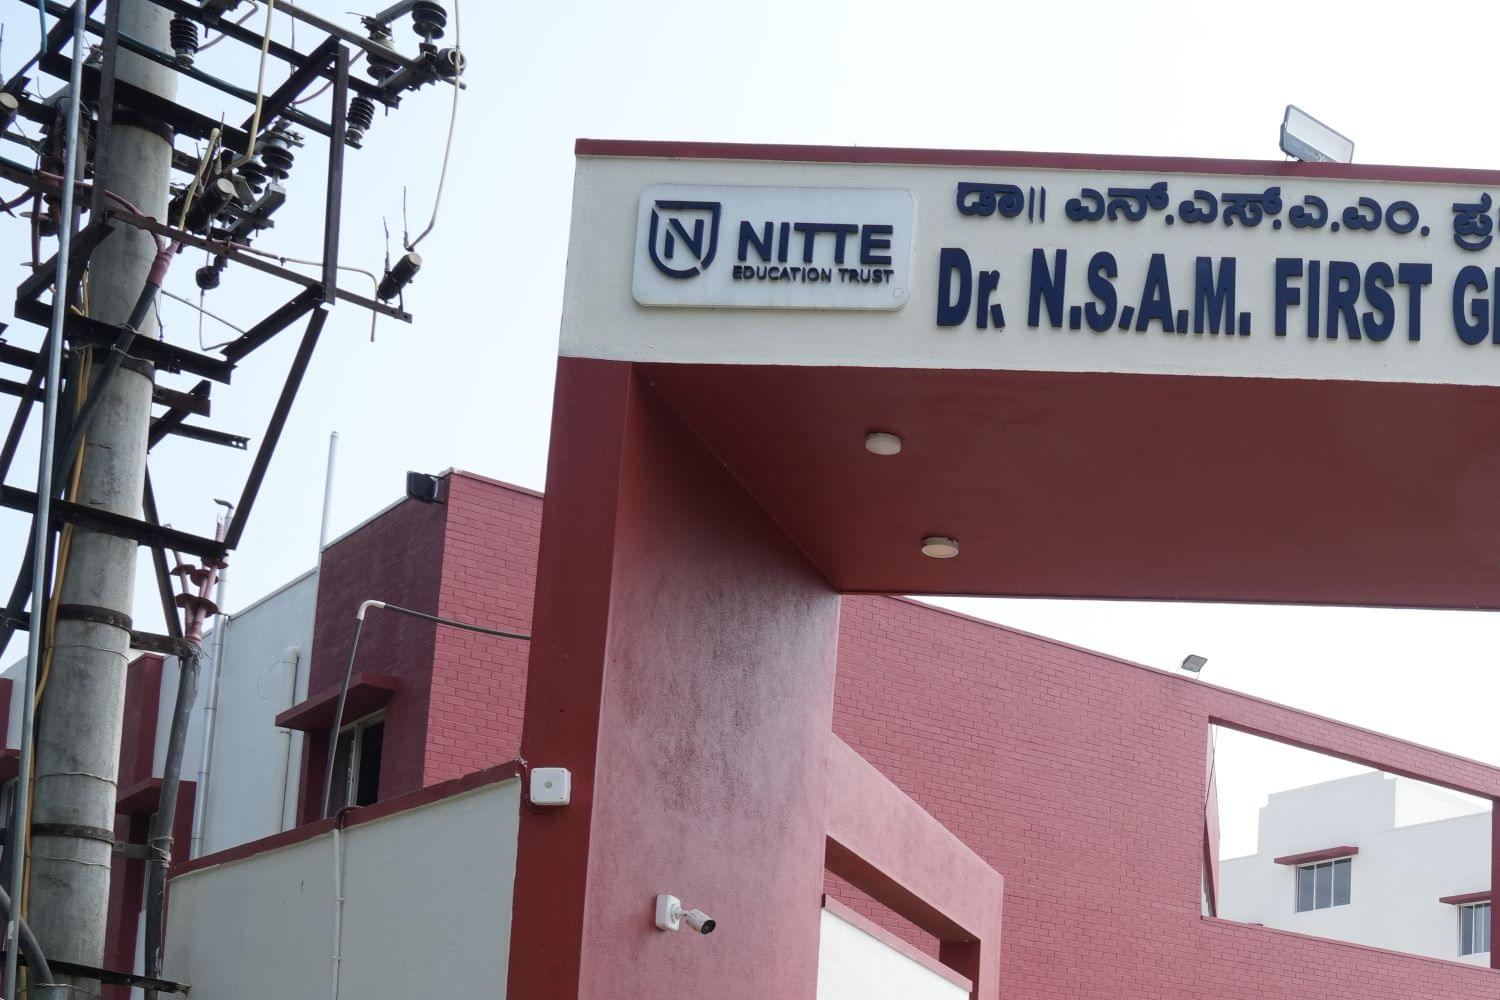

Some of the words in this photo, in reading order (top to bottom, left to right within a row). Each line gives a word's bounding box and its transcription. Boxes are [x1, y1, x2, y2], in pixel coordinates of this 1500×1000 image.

[738, 221, 894, 269] NITTE
[732, 264, 833, 284] EDUCATION
[838, 267, 895, 285] TRUST
[936, 248, 1005, 331] Dr.
[1027, 249, 1252, 337] N.S.A.M.
[1275, 258, 1433, 343] FIRST
